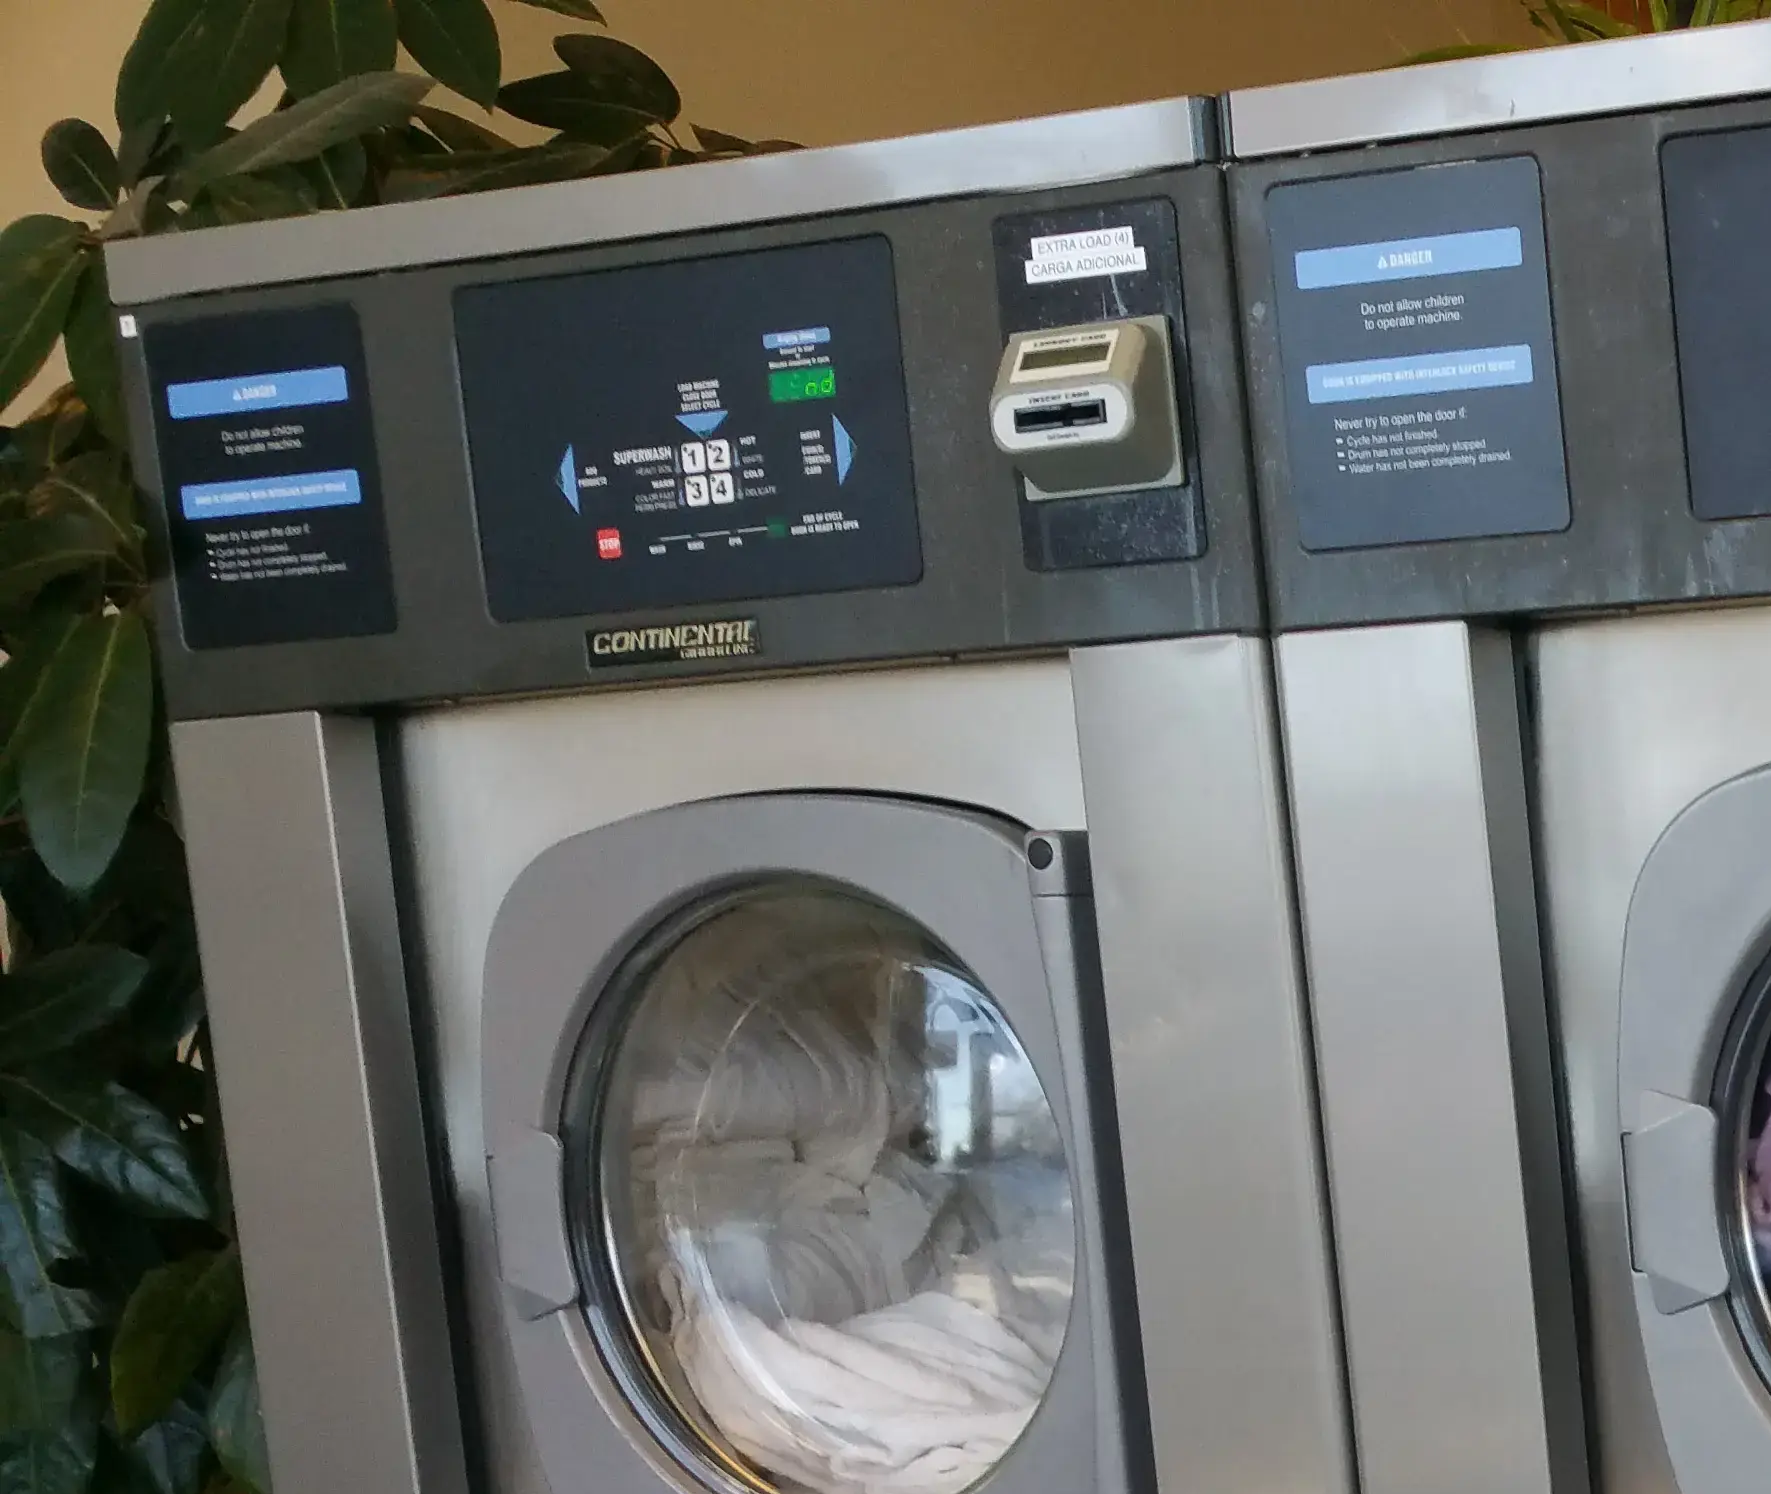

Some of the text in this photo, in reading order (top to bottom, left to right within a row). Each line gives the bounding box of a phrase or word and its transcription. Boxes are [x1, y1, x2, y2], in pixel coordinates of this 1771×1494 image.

[1038, 231, 1129, 255] EXTRA LOAD (4)
[1031, 252, 1140, 277] CARGA ADICIONAL
[1390, 250, 1433, 267] DANGER
[1360, 294, 1465, 316] Do not allow children
[1364, 310, 1463, 331] to operate machine.
[613, 445, 672, 466] SUPERWASH
[691, 446, 724, 466] 1 2
[692, 483, 702, 499] 3
[716, 480, 727, 497] 4
[593, 620, 757, 655] CONTINENTAL
